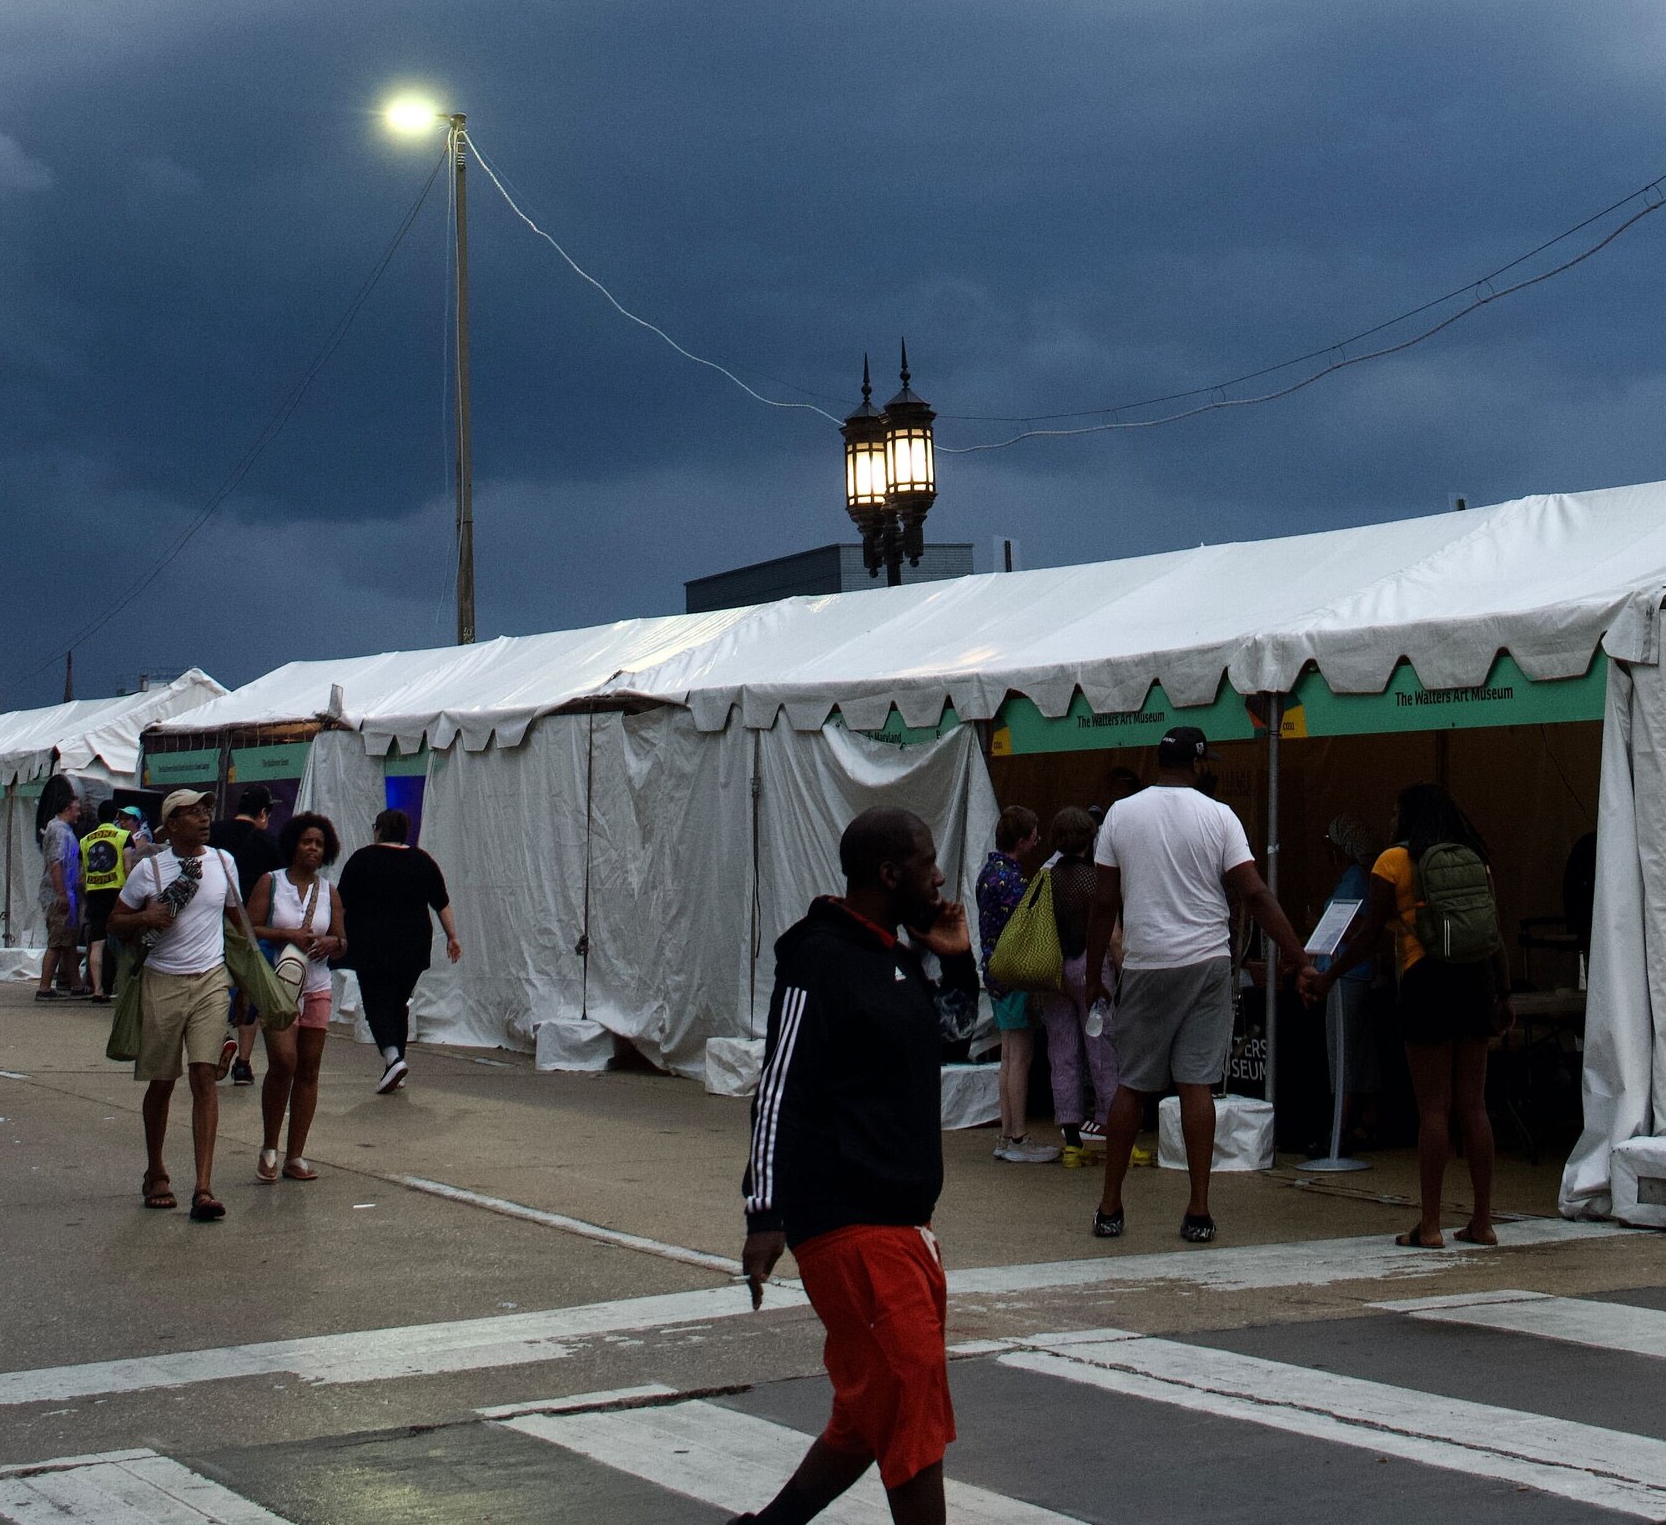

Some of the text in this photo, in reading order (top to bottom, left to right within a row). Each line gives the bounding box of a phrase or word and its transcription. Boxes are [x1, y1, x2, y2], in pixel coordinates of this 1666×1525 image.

[1395, 685, 1514, 707] The Walters Art Museum
[1076, 710, 1166, 729] The Walters Art Museum
